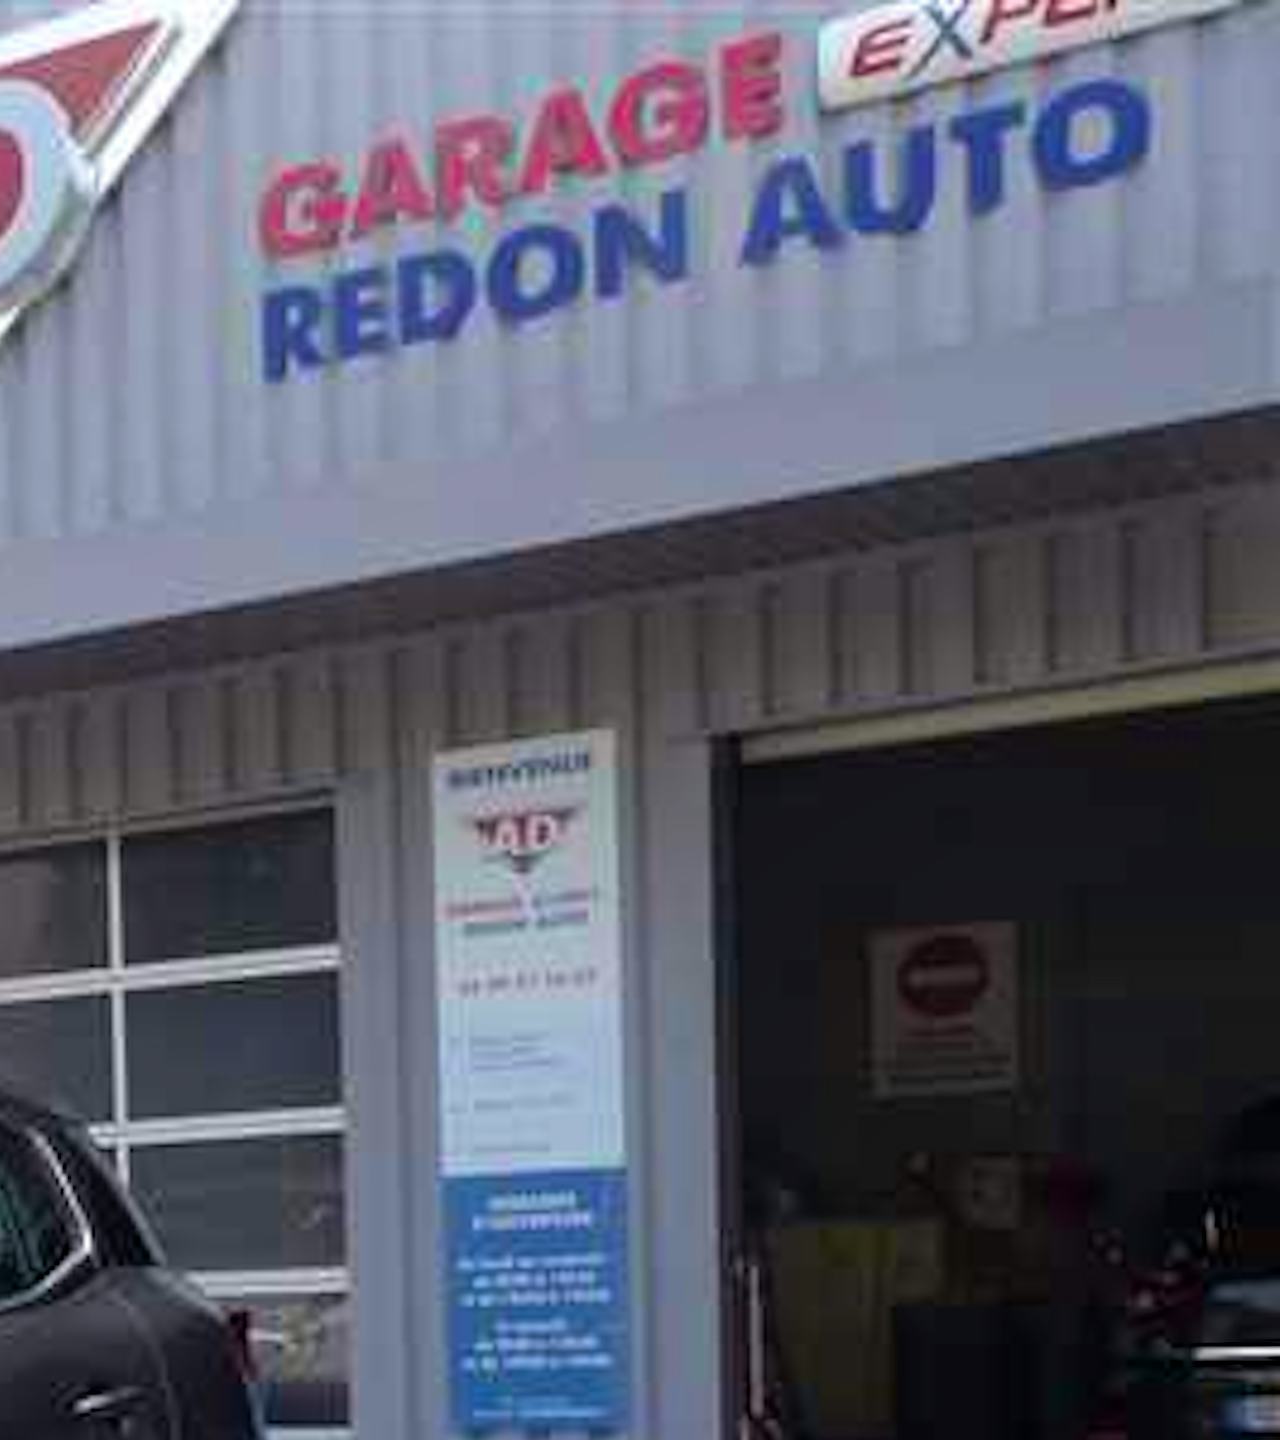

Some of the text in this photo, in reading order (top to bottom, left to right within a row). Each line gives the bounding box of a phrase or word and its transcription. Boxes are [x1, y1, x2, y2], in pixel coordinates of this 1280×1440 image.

[257, 31, 782, 261] GARAGE
[260, 76, 1152, 382] REDON AUTO
